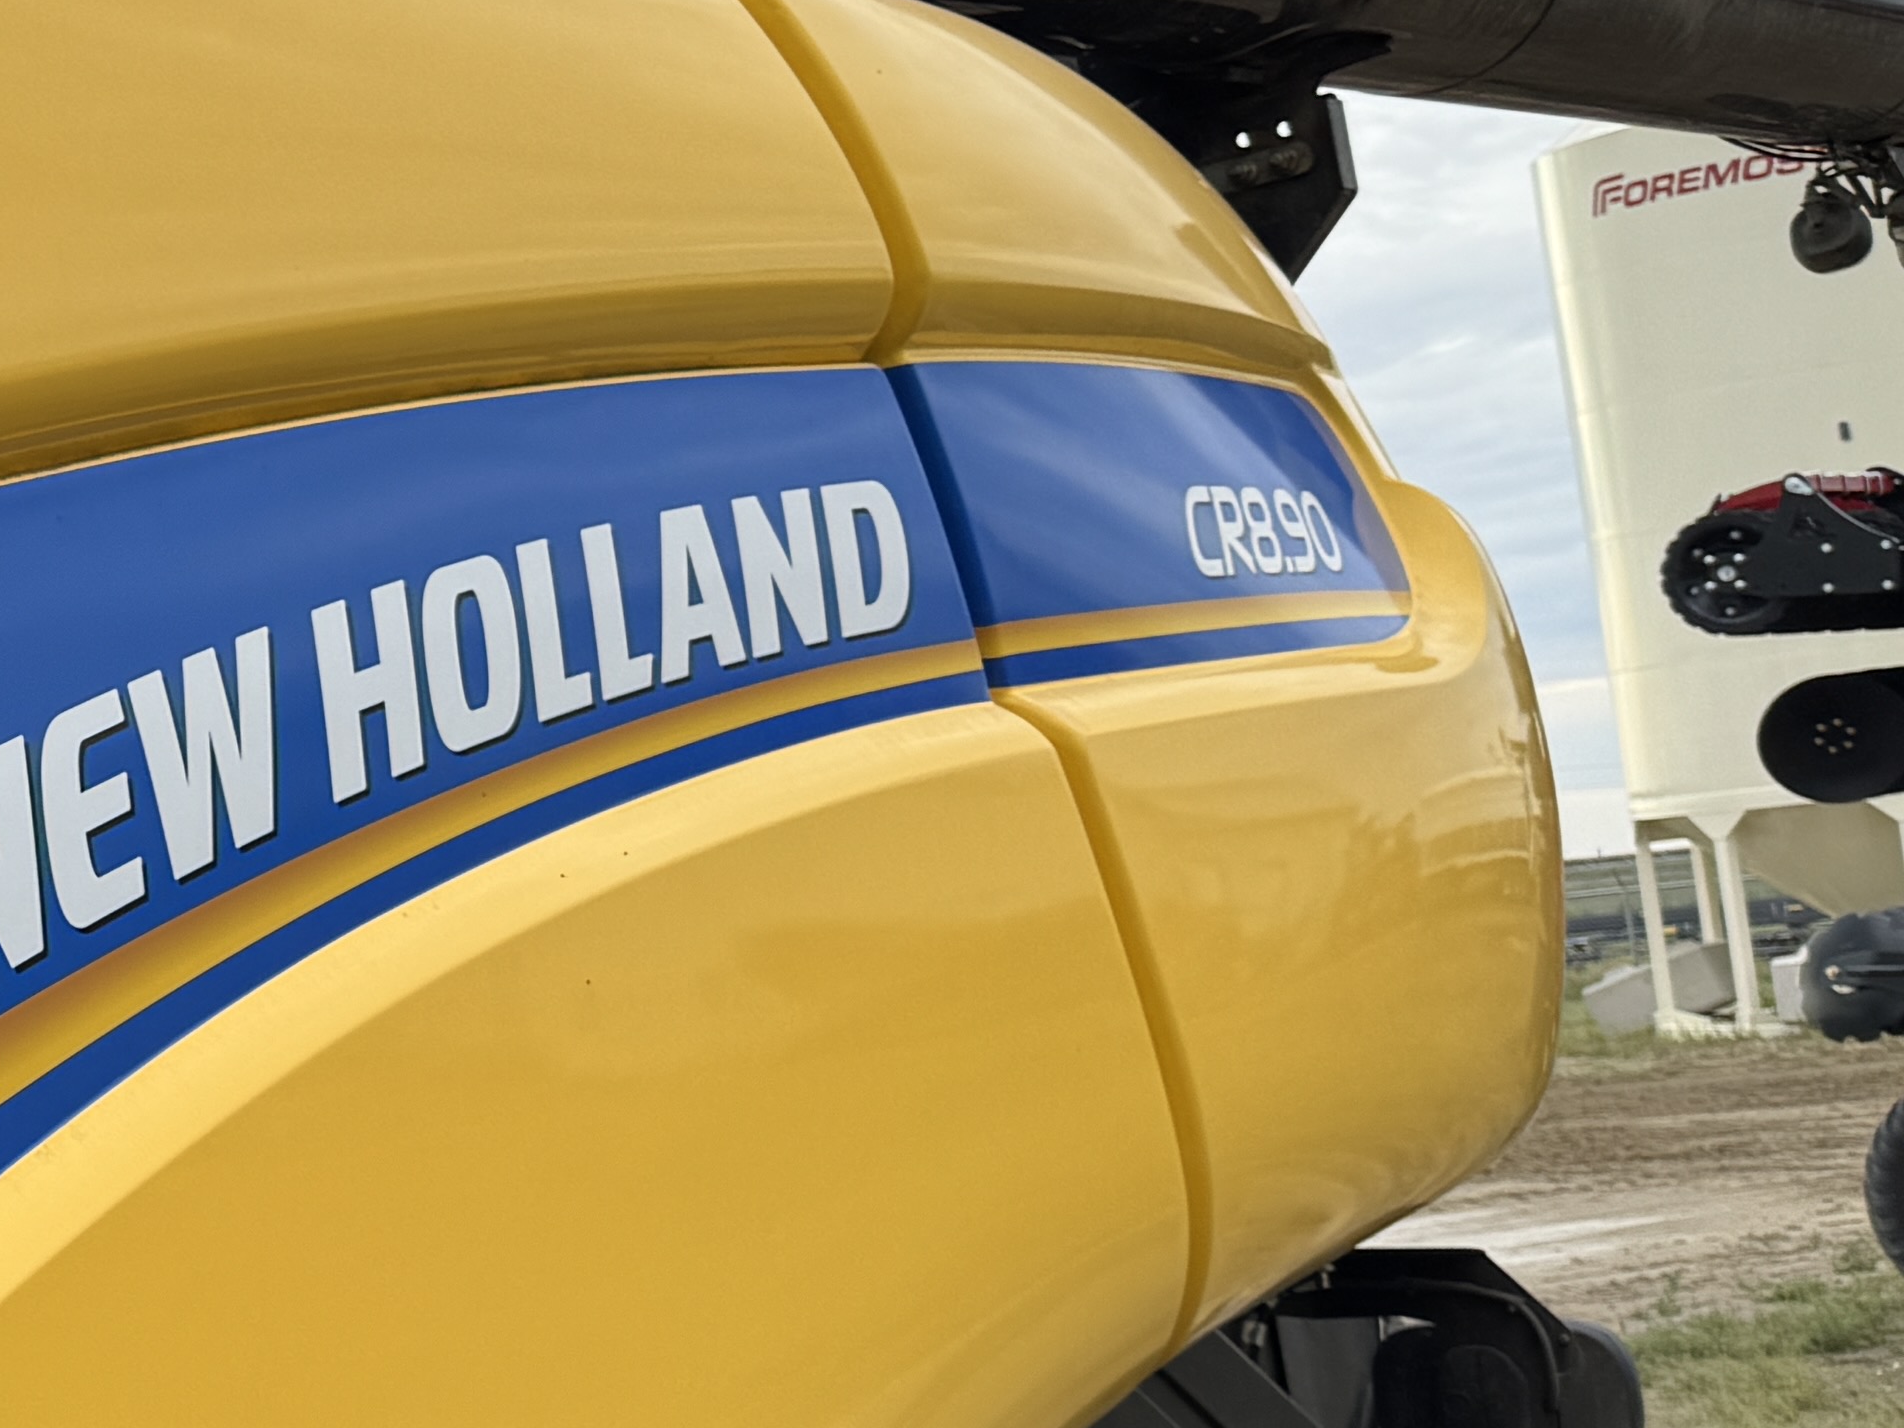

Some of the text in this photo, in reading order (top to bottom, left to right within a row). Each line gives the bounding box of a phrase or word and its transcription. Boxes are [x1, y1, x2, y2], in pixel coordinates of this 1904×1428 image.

[1592, 148, 1814, 218] FOREMOS
[1184, 484, 1343, 578] CR8.90
[311, 478, 912, 803] HOLLAND
